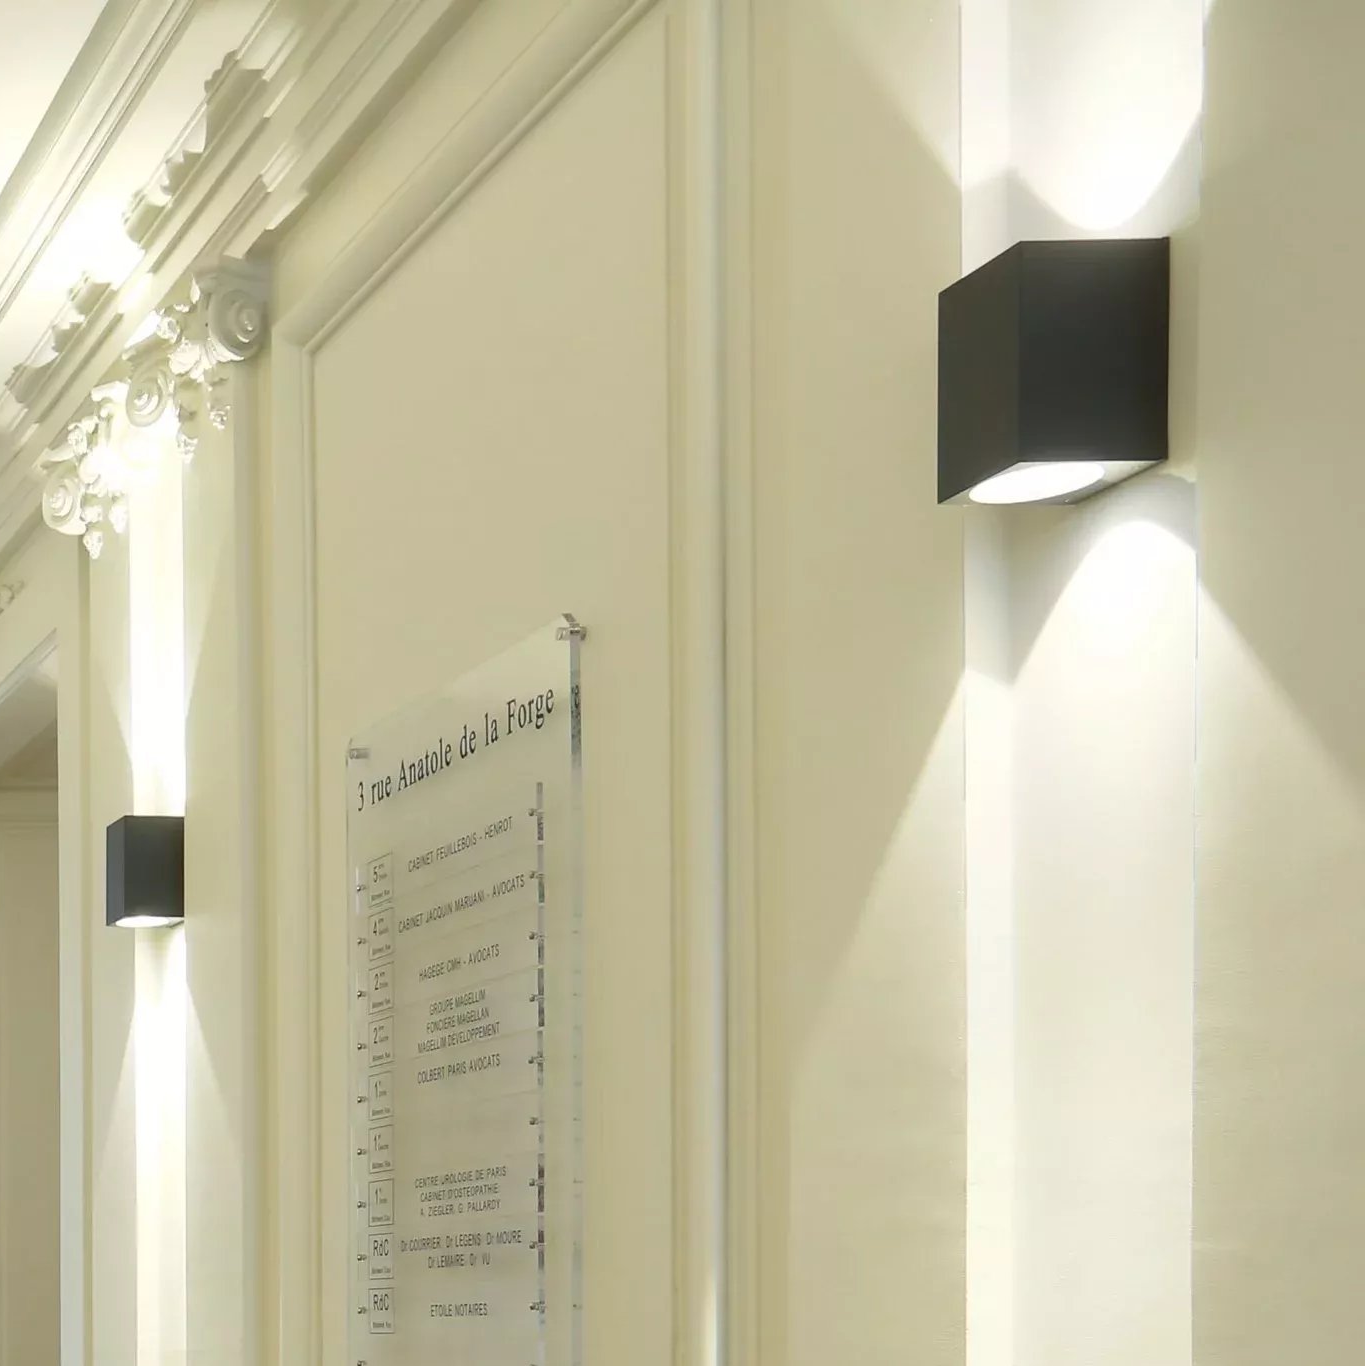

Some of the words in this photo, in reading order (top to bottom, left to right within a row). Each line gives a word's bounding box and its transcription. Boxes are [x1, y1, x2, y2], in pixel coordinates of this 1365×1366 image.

[357, 781, 364, 812] 3
[371, 774, 392, 805] rue
[397, 737, 452, 792] Anatole
[459, 724, 476, 760] de
[484, 712, 499, 747] la
[506, 688, 555, 736] Forge
[407, 850, 434, 873] CABINET
[436, 832, 477, 860] FEUILLEBOIS
[484, 816, 513, 840] HENROT
[398, 912, 424, 933] CABINET
[425, 900, 453, 924] JACQUIN
[492, 874, 526, 899] AVOCATS
[468, 943, 500, 966] AVOCATS
[429, 996, 453, 1016] GROUPE
[426, 1014, 455, 1034] FONCIERE
[456, 1007, 490, 1026] MAGELLAN
[447, 1021, 500, 1047] DEVELOPPEMENT
[417, 1066, 445, 1084] COLBERT
[447, 1059, 467, 1078] PARIS
[469, 1053, 501, 1073] AVOCATS
[414, 1175, 438, 1189] CENTRE
[442, 1170, 473, 1186] UROLOGIE
[475, 1169, 484, 1181] DE
[486, 1165, 507, 1179] PARIS
[420, 1189, 445, 1203] CABINET
[467, 1199, 501, 1213] PALLARDY
[372, 1239, 389, 1257] RdC
[372, 1294, 390, 1311] RdC
[430, 1304, 453, 1317] ETOILE
[455, 1303, 488, 1316] NOTAIRES
